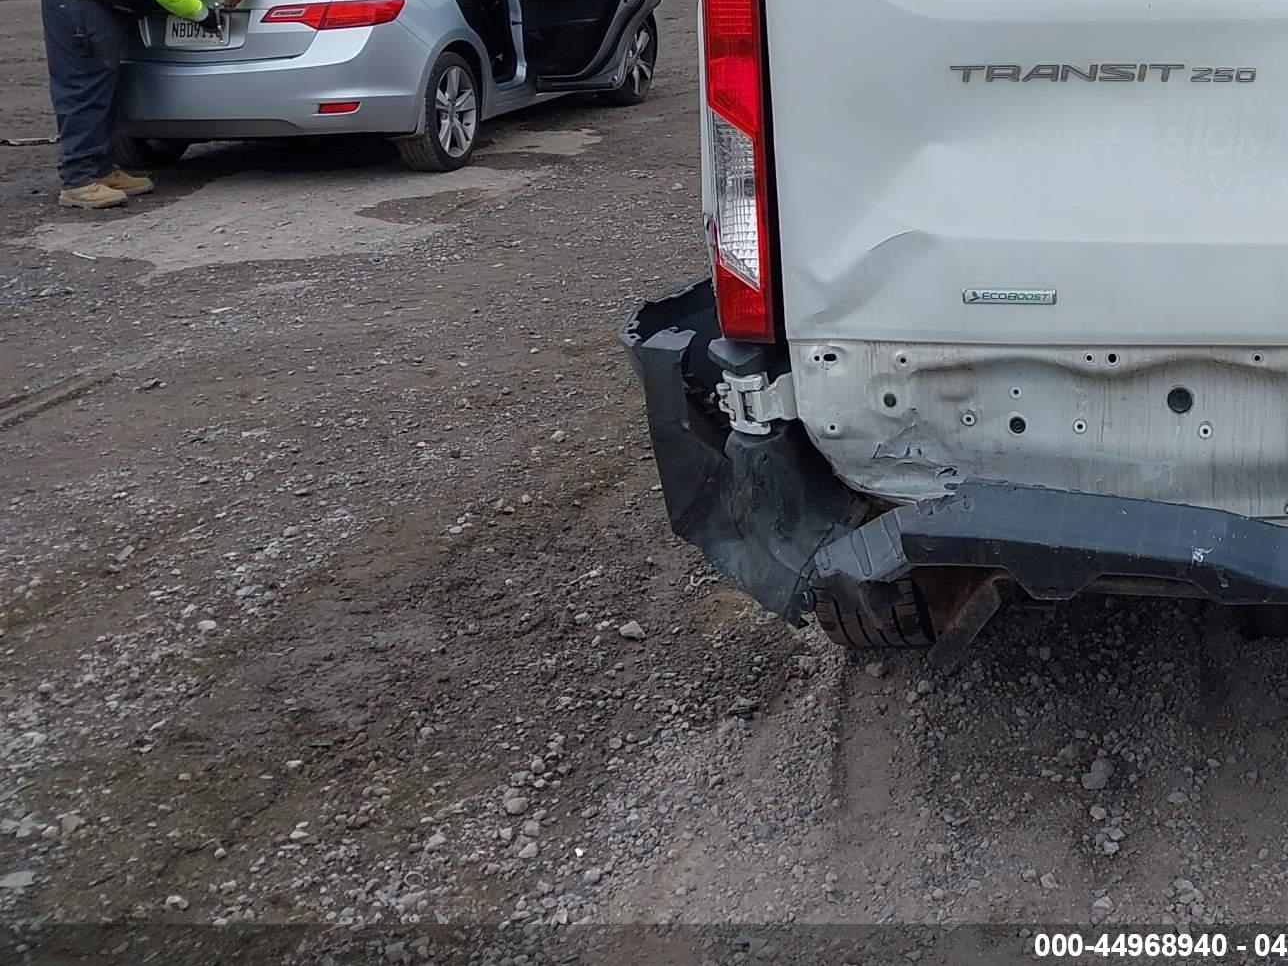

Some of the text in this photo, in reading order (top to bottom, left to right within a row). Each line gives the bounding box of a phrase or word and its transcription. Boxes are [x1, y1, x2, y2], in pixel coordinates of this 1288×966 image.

[171, 22, 221, 38] NBD9
[949, 63, 1257, 83] TRANSIT 250
